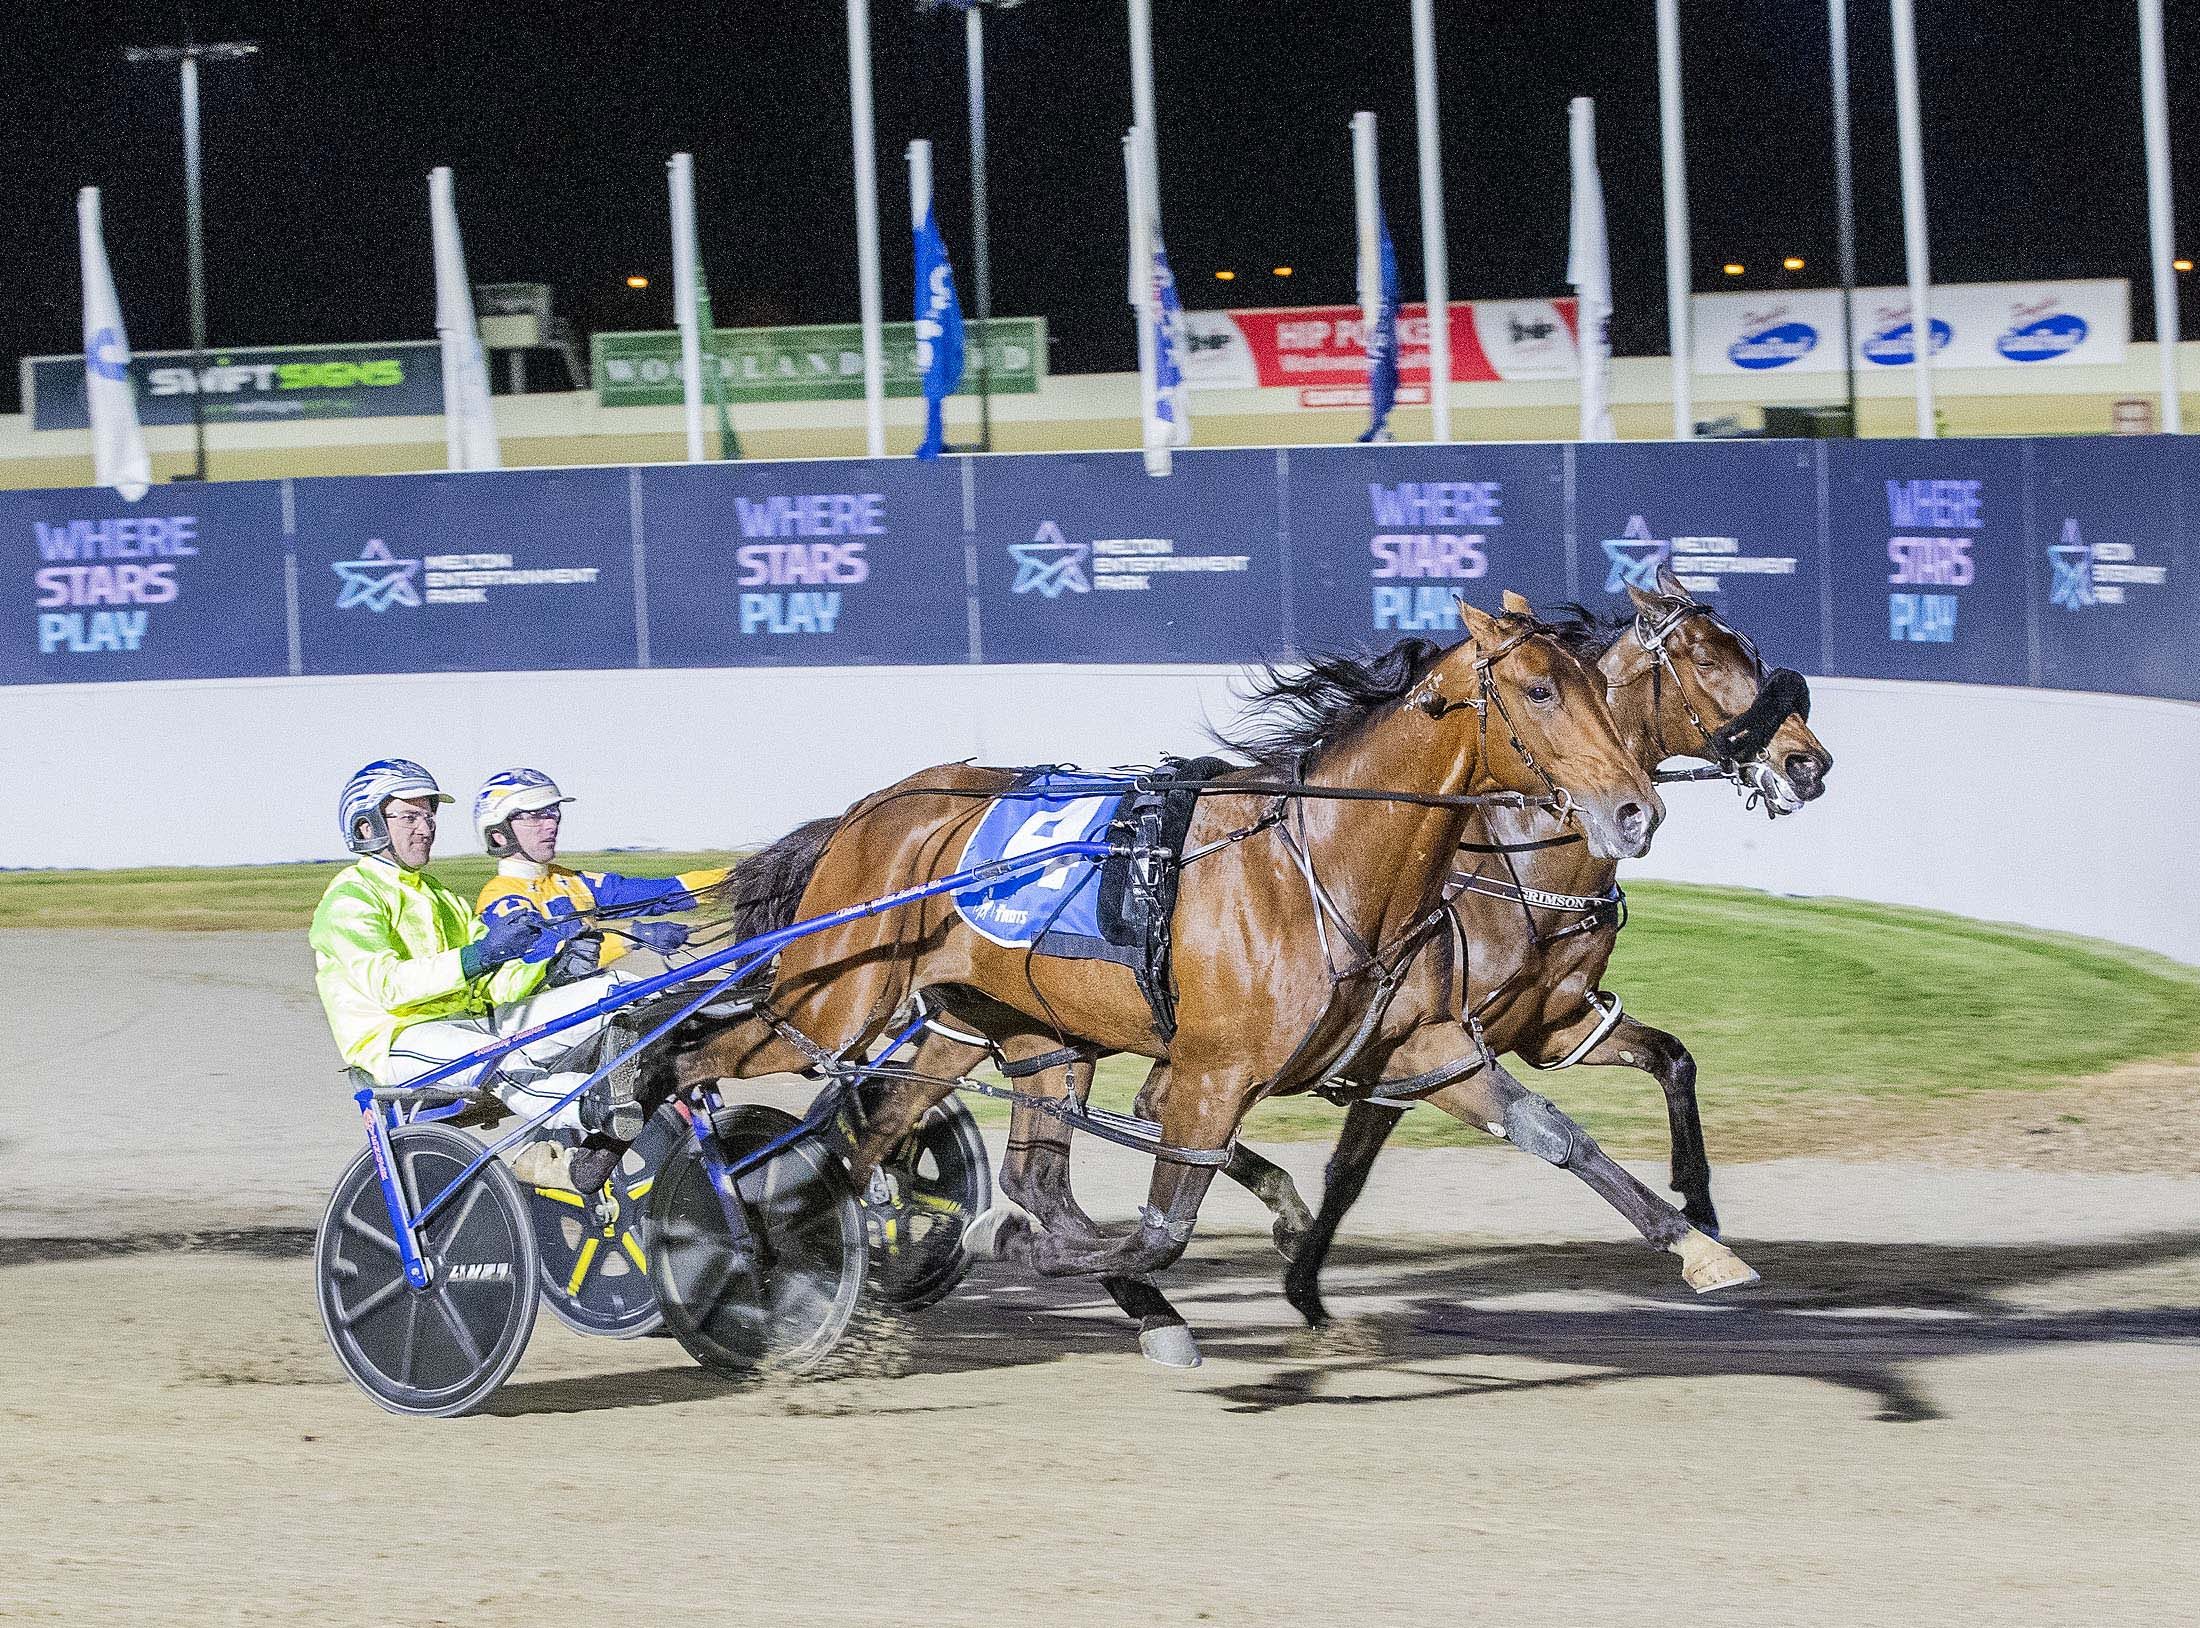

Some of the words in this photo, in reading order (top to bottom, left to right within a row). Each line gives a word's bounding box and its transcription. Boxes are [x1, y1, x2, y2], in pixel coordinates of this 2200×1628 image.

[735, 493, 887, 537] WHERE
[1368, 482, 1503, 525] WHERE
[33, 516, 199, 561] WHERE
[1370, 534, 1488, 578] STARS
[34, 562, 178, 607] STARS
[737, 542, 868, 585] STARS
[740, 592, 841, 633] PLAY
[1373, 586, 1464, 630] PLAY
[38, 610, 150, 652] PLAY
